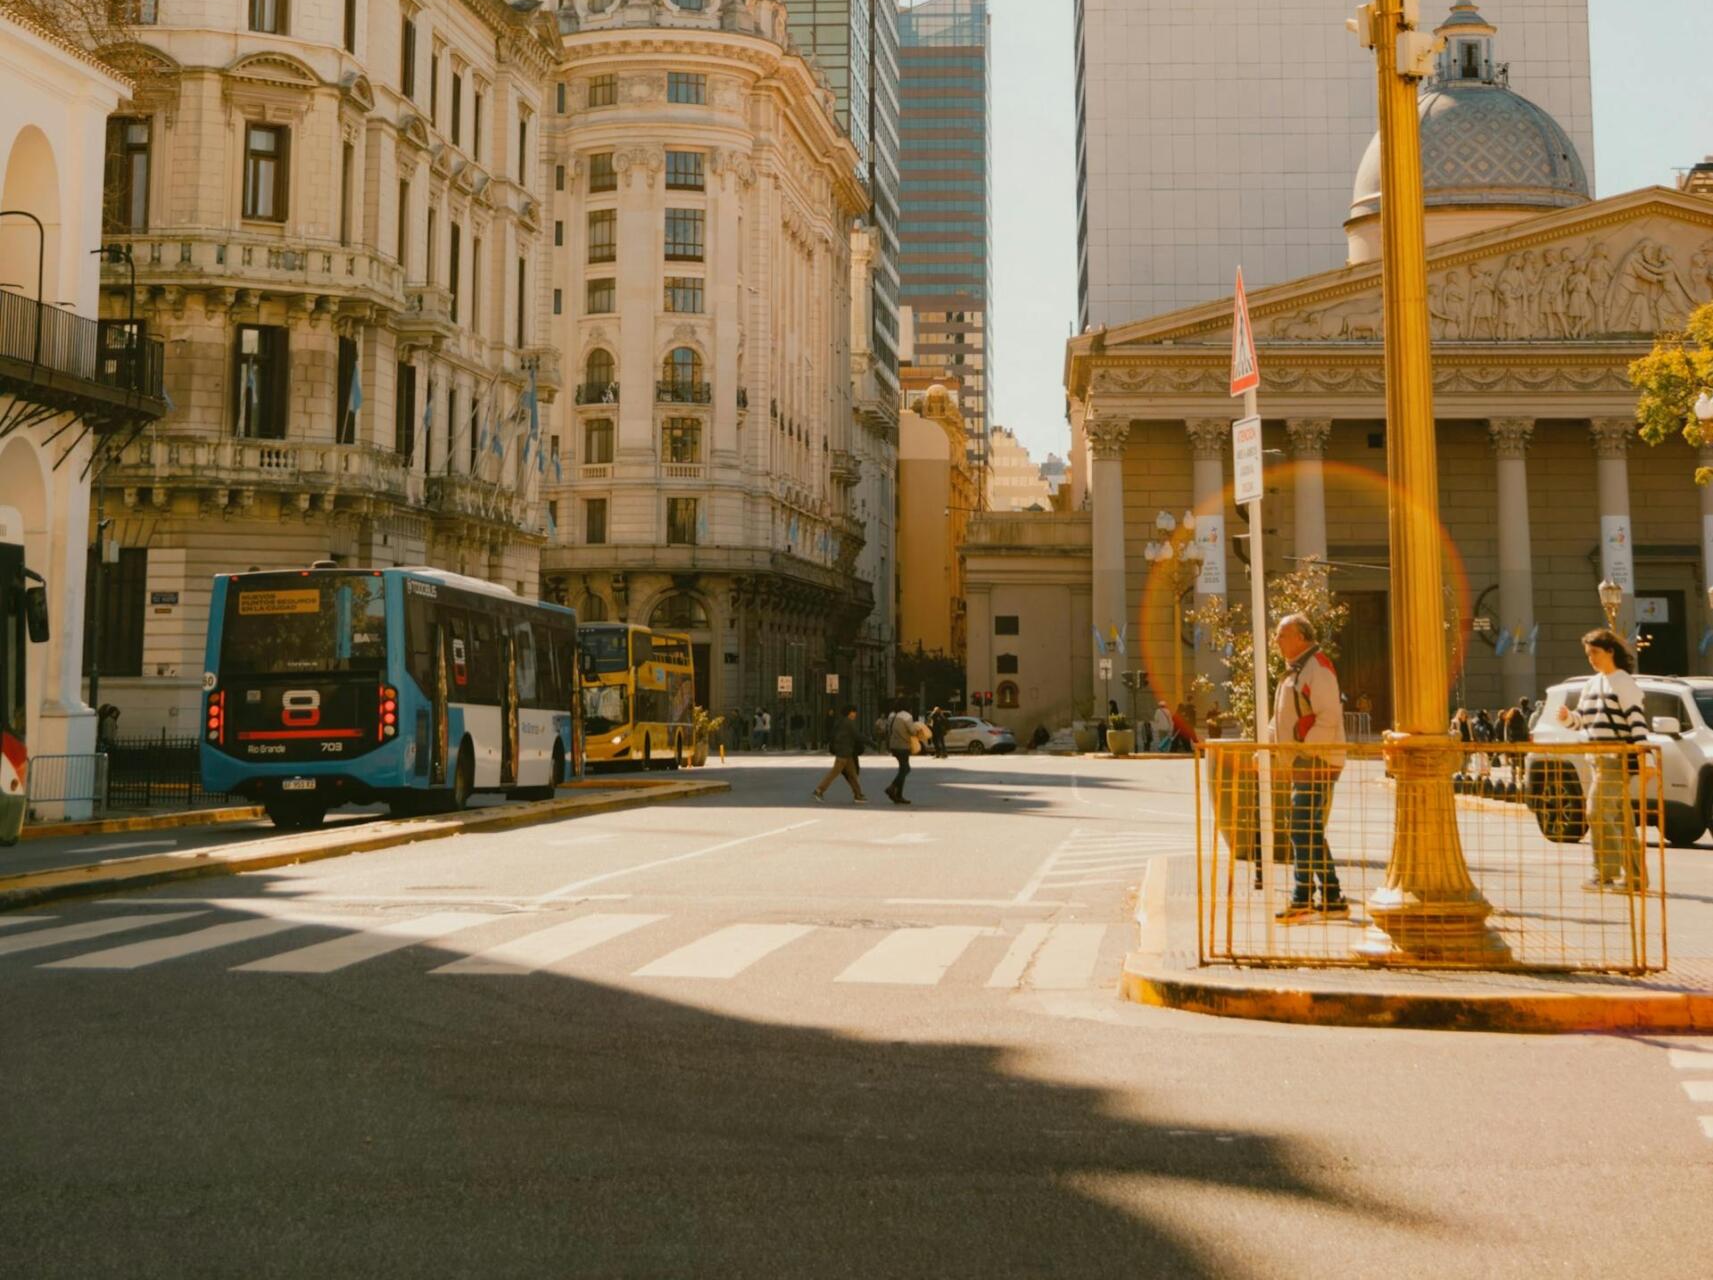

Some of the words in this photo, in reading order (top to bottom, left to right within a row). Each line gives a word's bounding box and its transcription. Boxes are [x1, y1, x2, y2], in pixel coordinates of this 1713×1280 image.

[277, 597, 317, 605] SEGUROS
[282, 689, 321, 727] 8
[259, 743, 286, 754] Grande
[320, 742, 343, 752] 703
